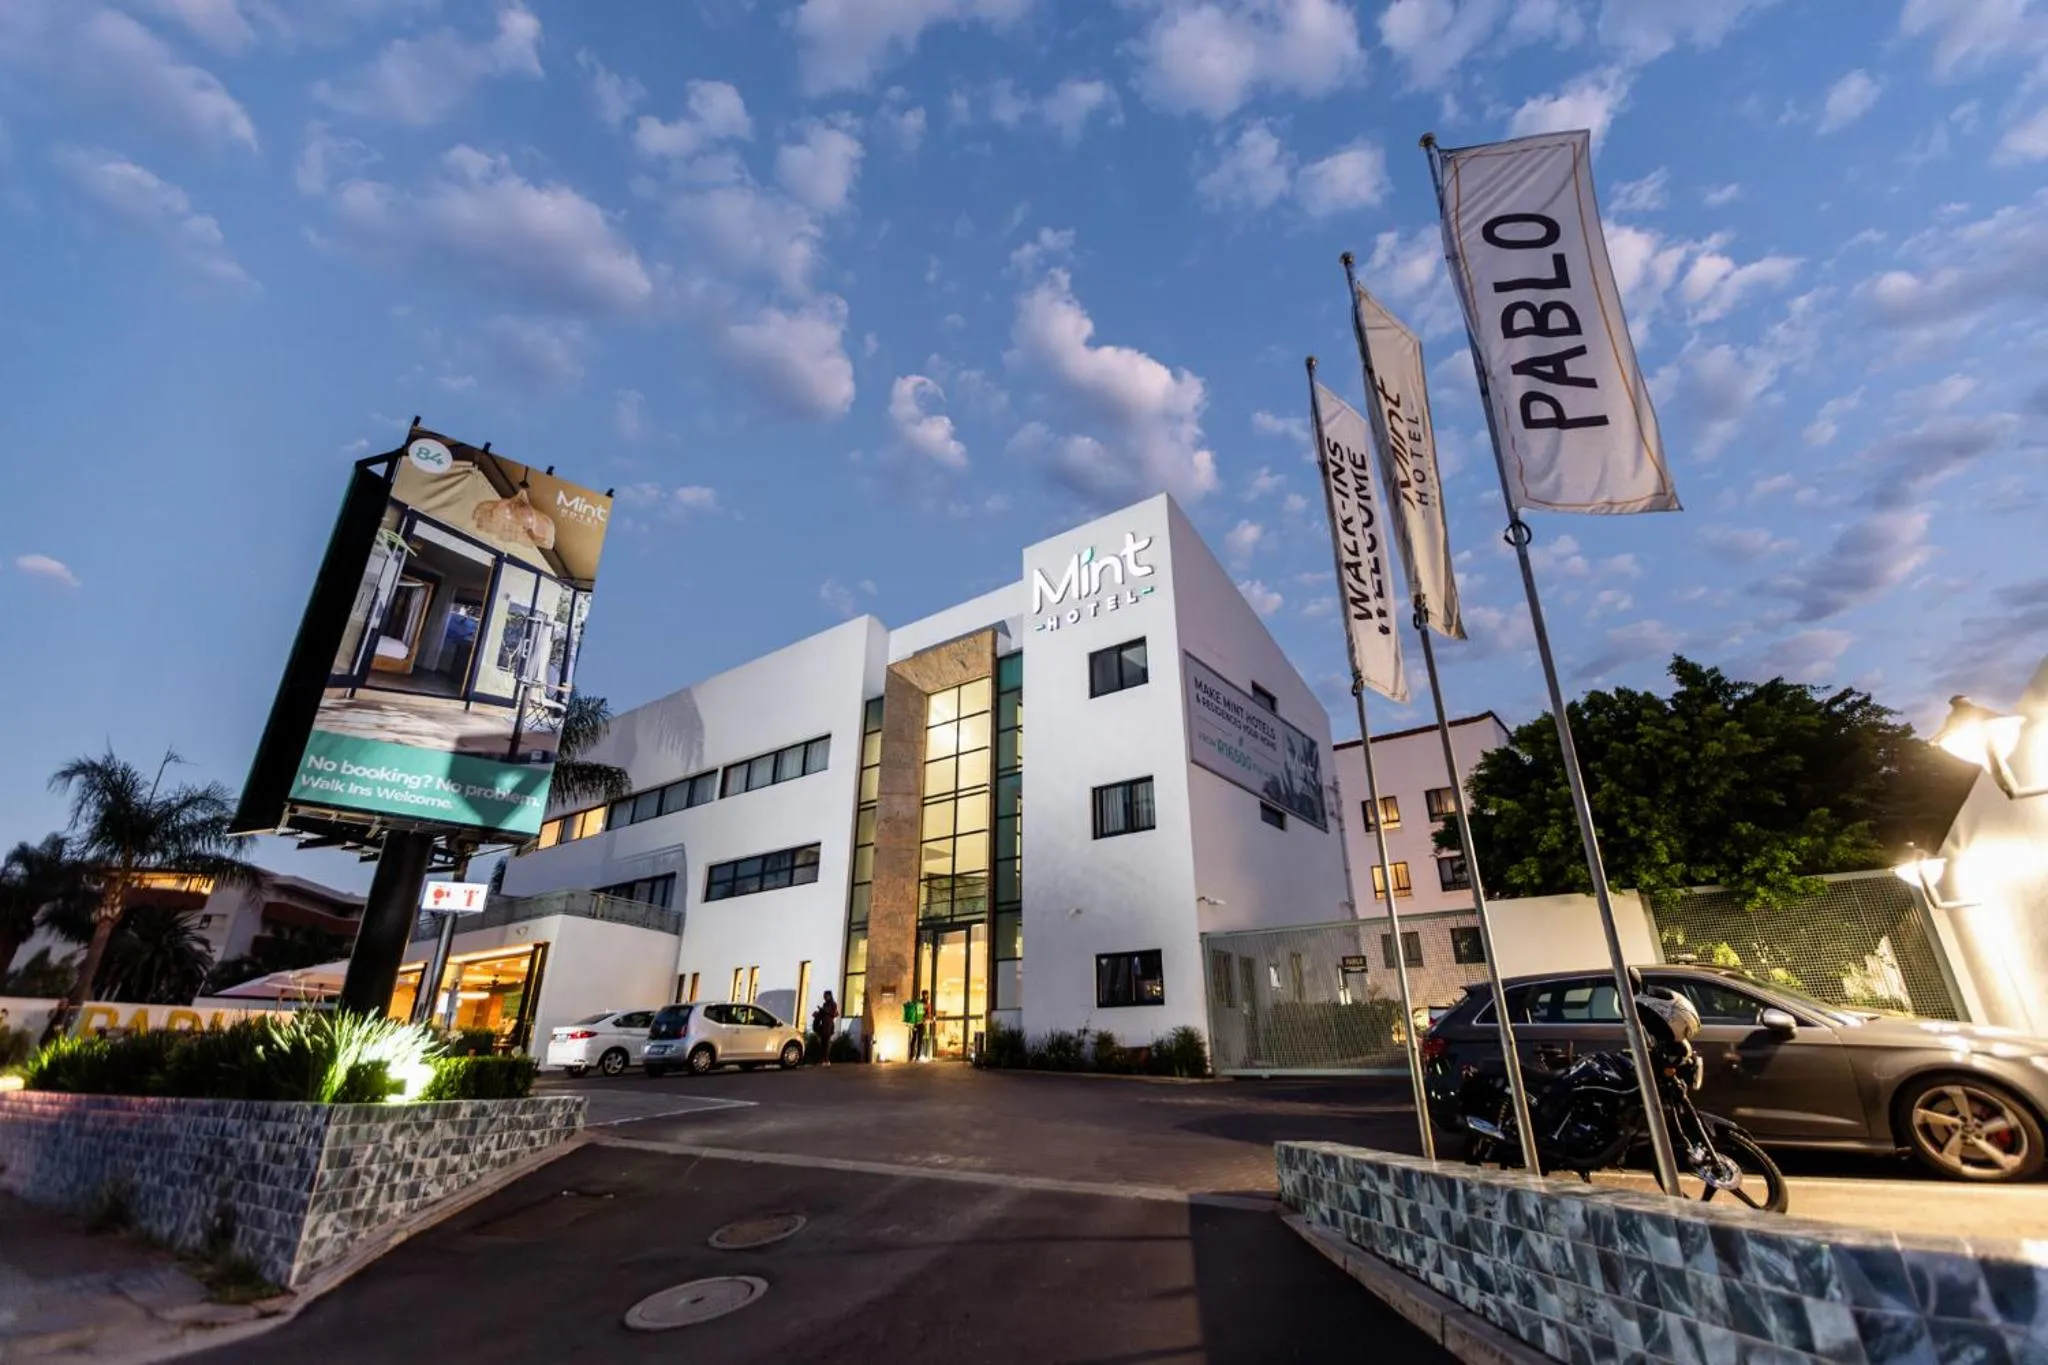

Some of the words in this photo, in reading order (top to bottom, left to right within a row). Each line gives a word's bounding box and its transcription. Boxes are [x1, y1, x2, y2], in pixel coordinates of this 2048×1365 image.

[1482, 213, 1610, 430] PABLO
[415, 447, 444, 466] 84
[1407, 416, 1429, 506] HOTEL
[556, 489, 607, 522] Mint
[1326, 437, 1373, 621] WALK-INS
[1033, 531, 1154, 614] Mint
[1047, 589, 1140, 631] HOTEL
[1194, 676, 1222, 705] MAKE
[1223, 696, 1244, 720] MINT
[1246, 711, 1276, 741] HOTELS
[301, 774, 346, 793] Walk
[347, 782, 373, 797] Ins
[376, 786, 454, 810] Welcome.
[307, 754, 338, 772] No
[340, 760, 434, 789] booking?
[436, 776, 463, 793] No
[465, 784, 541, 807] problem.
